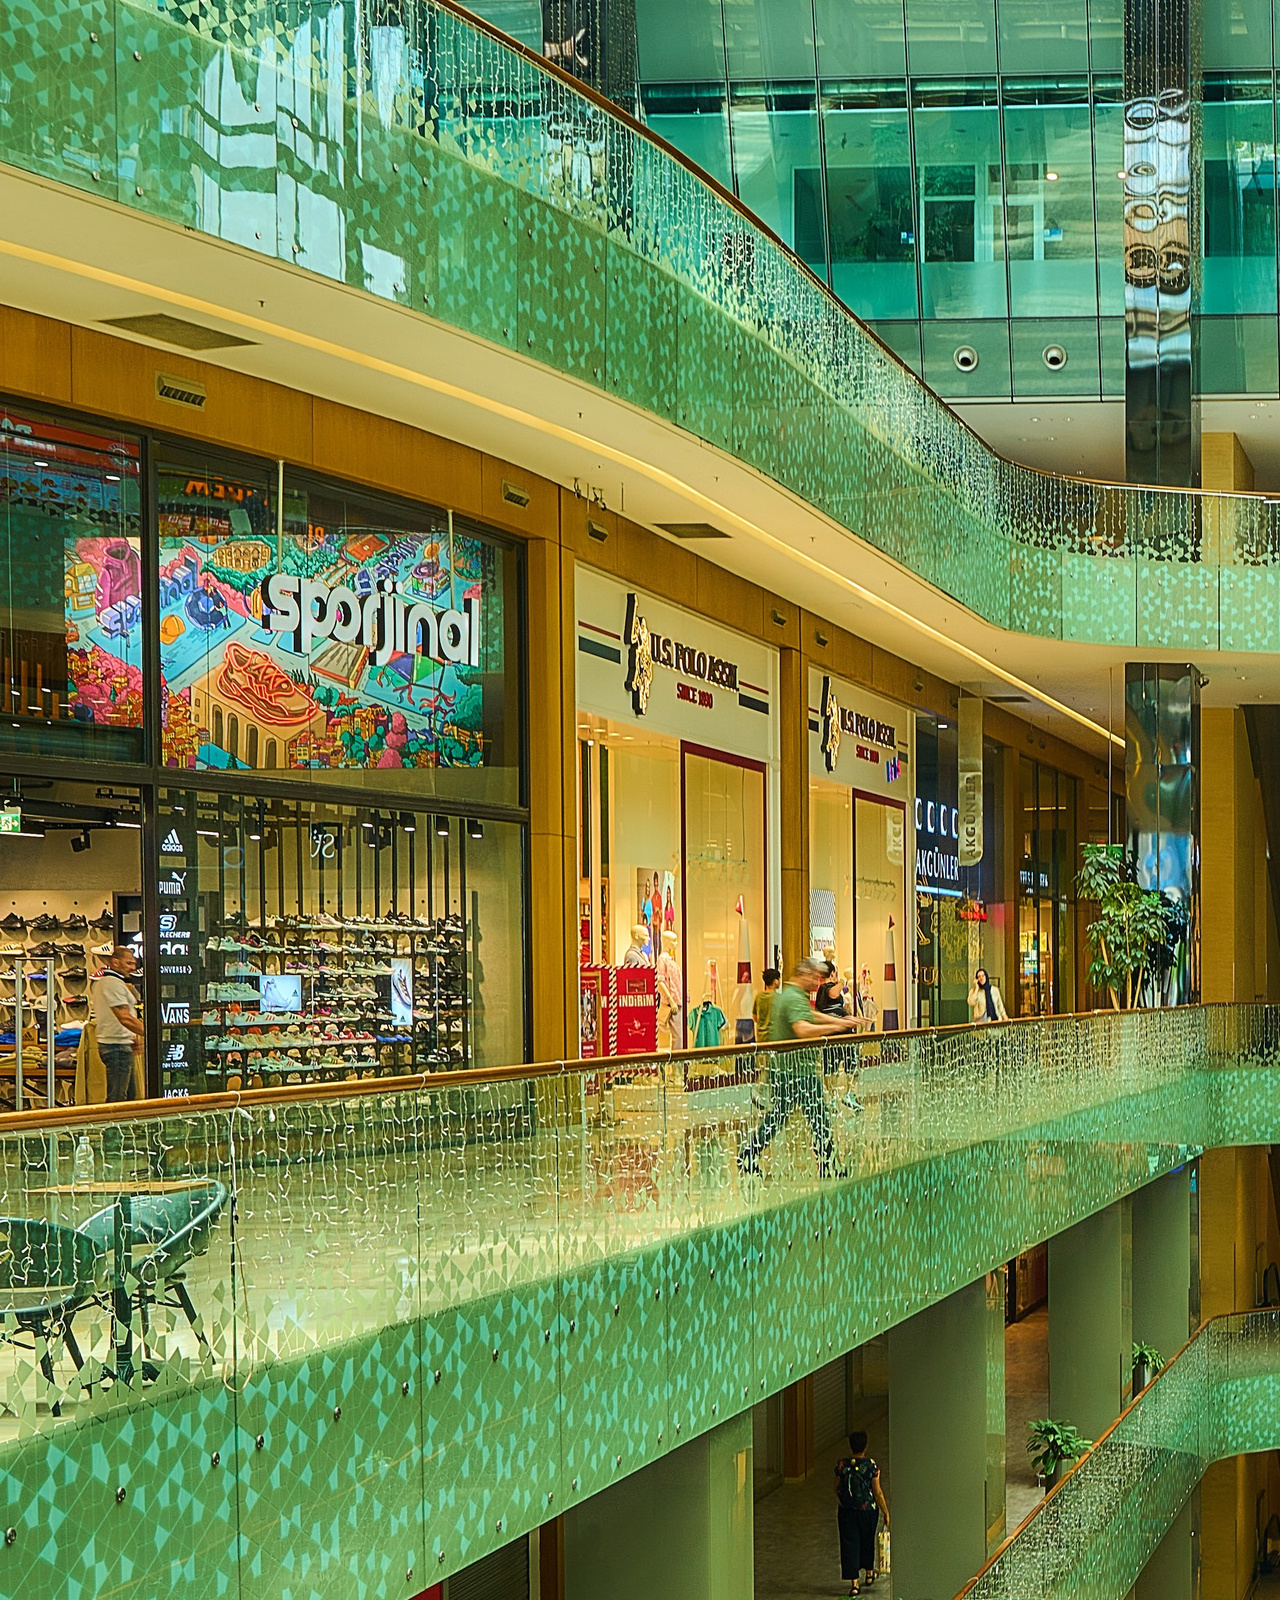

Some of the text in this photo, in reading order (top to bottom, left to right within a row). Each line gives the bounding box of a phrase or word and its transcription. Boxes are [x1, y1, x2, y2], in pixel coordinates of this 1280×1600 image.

[263, 574, 480, 668] sporjinal
[673, 641, 707, 680] POLO
[676, 682, 698, 704] SINCE
[963, 775, 977, 859] AKGÜNLER
[161, 843, 184, 853] adidas
[915, 846, 960, 882] AKGÜNLER
[158, 880, 182, 895] PUMA
[160, 1002, 190, 1024] VANS
